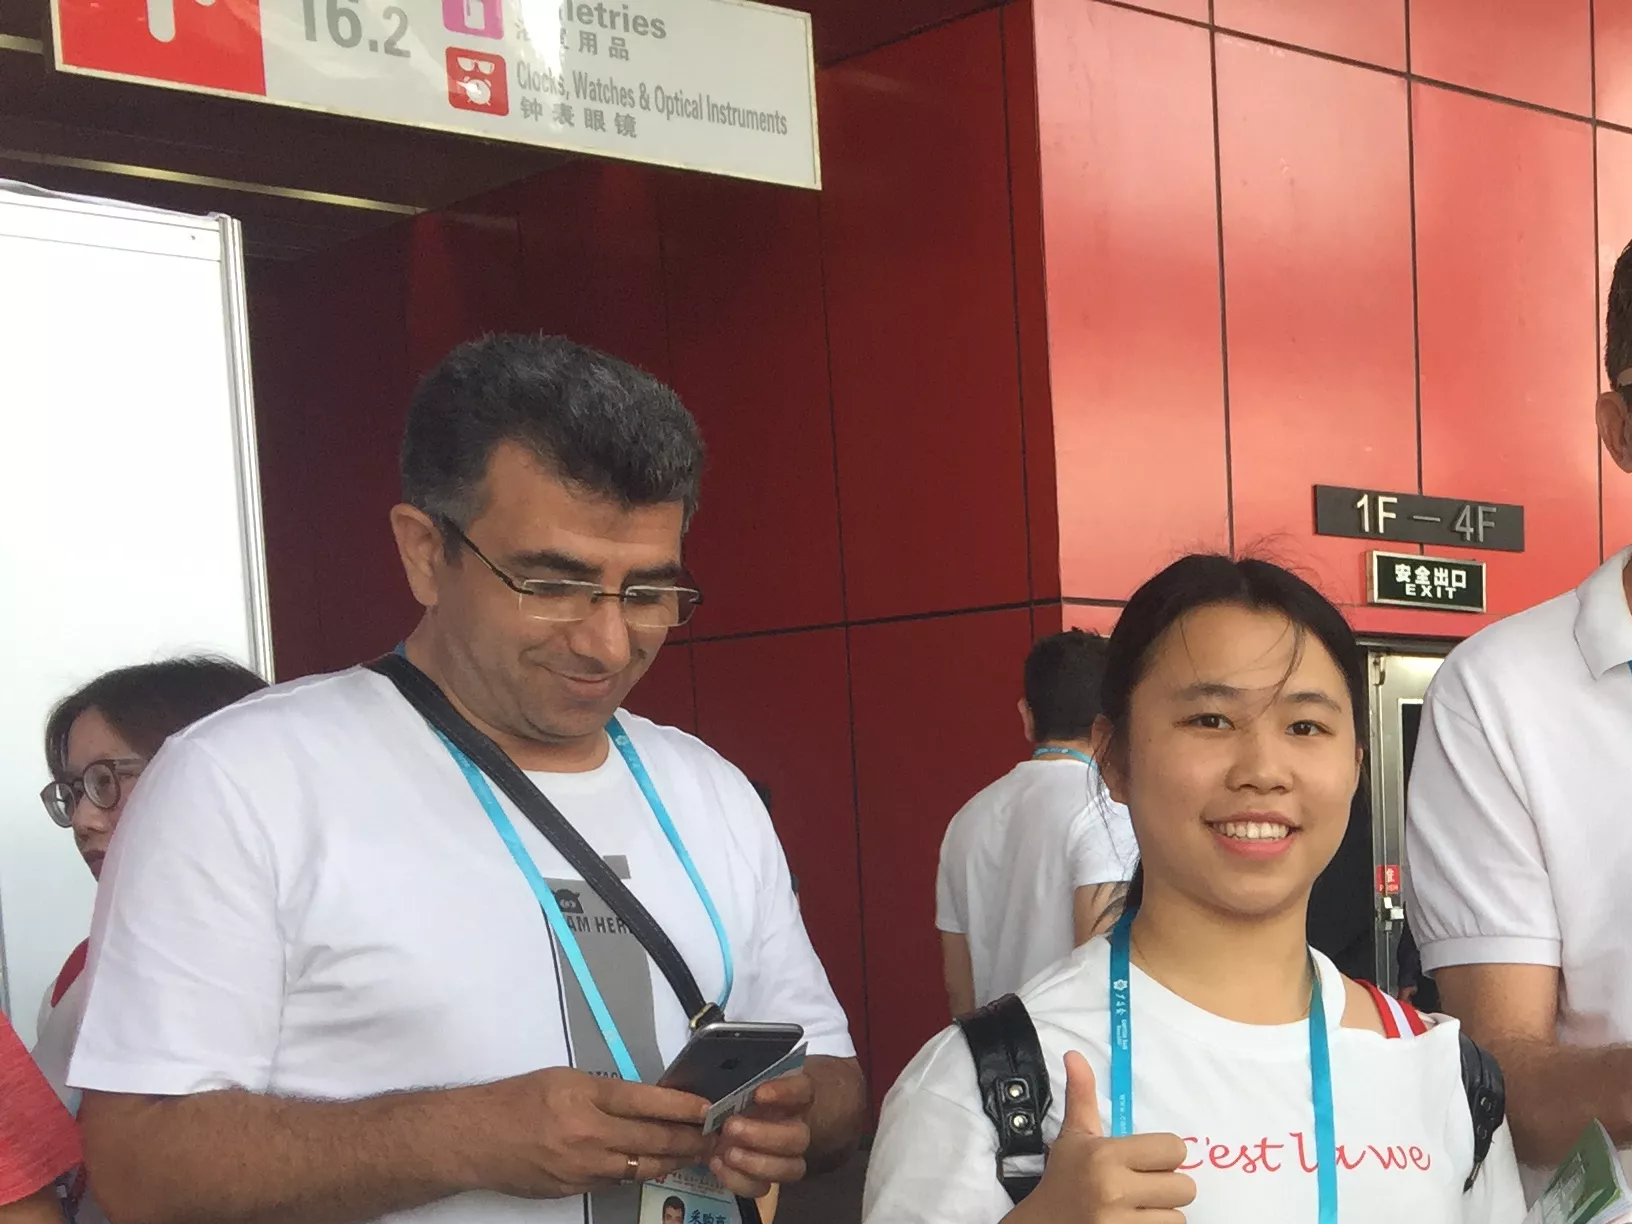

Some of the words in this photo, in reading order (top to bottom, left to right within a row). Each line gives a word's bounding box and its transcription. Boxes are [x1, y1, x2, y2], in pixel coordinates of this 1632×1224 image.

[301, 0, 411, 58] 16.2
[516, 60, 569, 100] Clocks,
[572, 69, 636, 109] Watches
[639, 82, 651, 111] &
[654, 85, 703, 121] Optical
[706, 98, 788, 135] Instruments
[520, 96, 637, 138] 钟表眼镜
[1356, 494, 1398, 534] 1F
[1455, 504, 1497, 542] 4F
[1394, 563, 1467, 588] 安全出口
[1405, 583, 1457, 599] EXIT
[1379, 884, 1399, 892] PSH
[595, 916, 632, 935] HER
[1176, 1136, 1285, 1174] C'est
